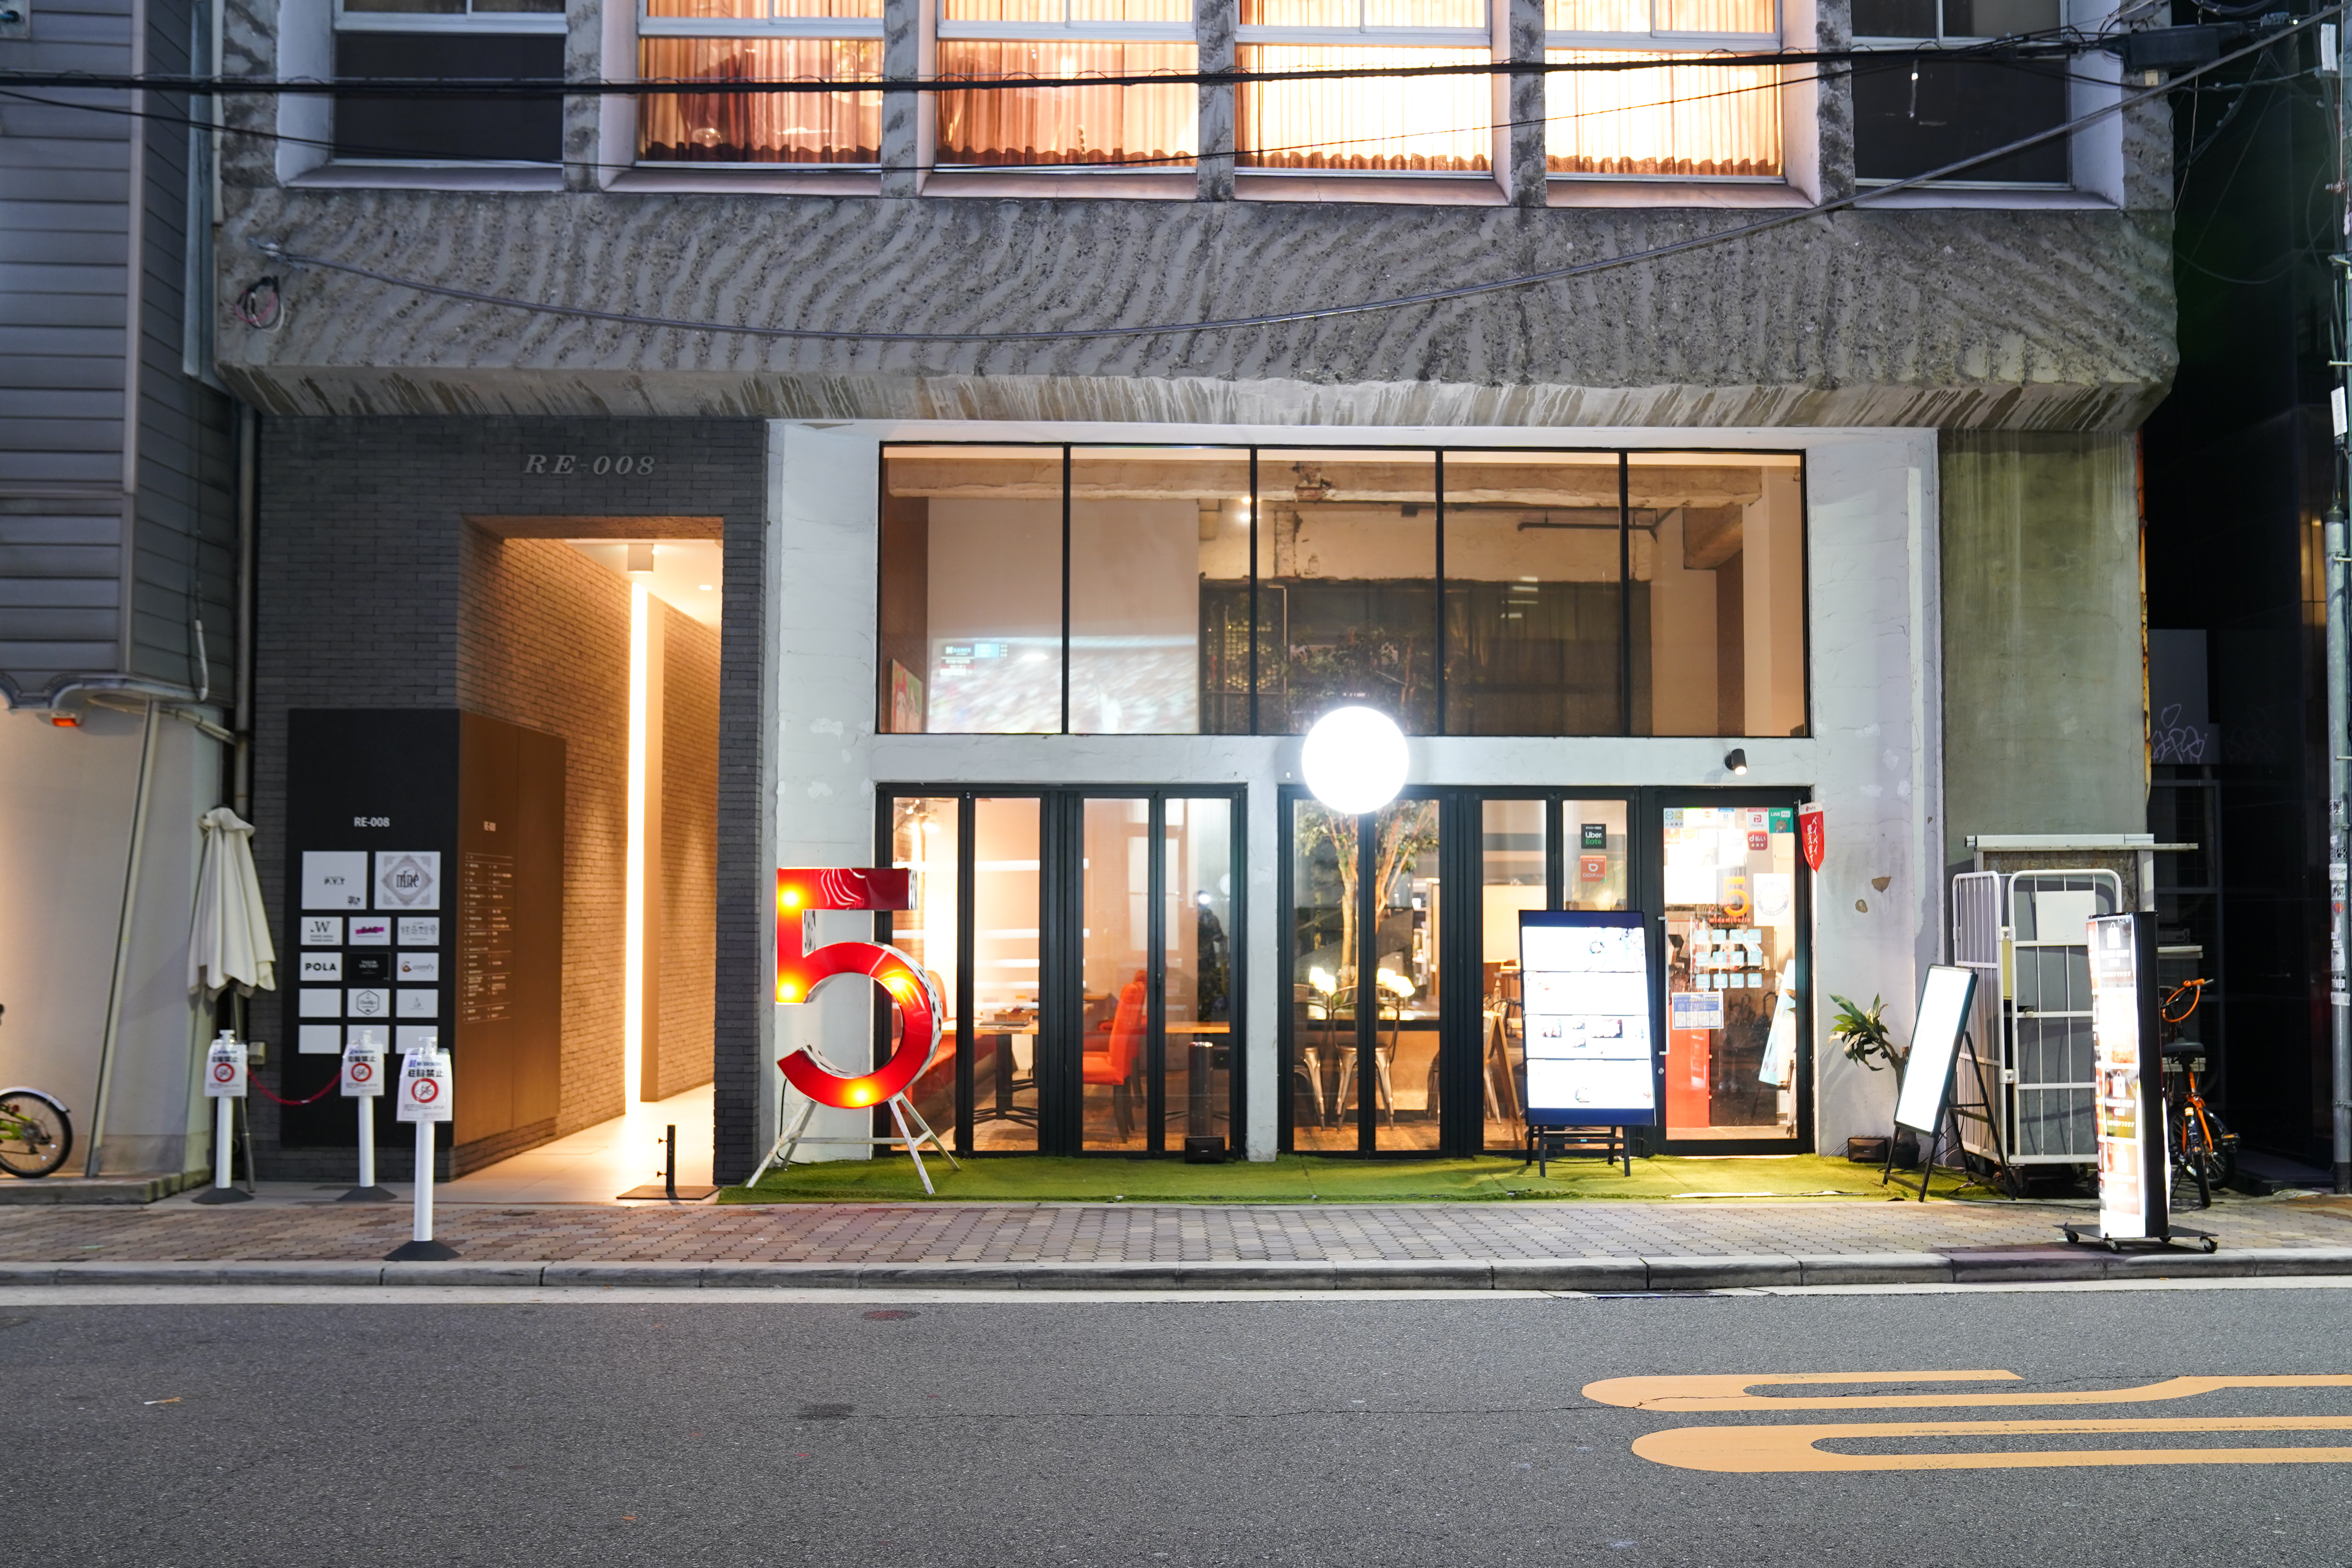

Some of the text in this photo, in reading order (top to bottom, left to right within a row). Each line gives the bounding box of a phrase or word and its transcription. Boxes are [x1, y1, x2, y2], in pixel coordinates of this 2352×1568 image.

[522, 454, 655, 475] RE-008
[354, 816, 390, 827] RE-008
[1749, 834, 1766, 842] d払い
[1724, 876, 1750, 917] 5
[305, 963, 337, 971] POLA
[776, 867, 942, 1108] 5
